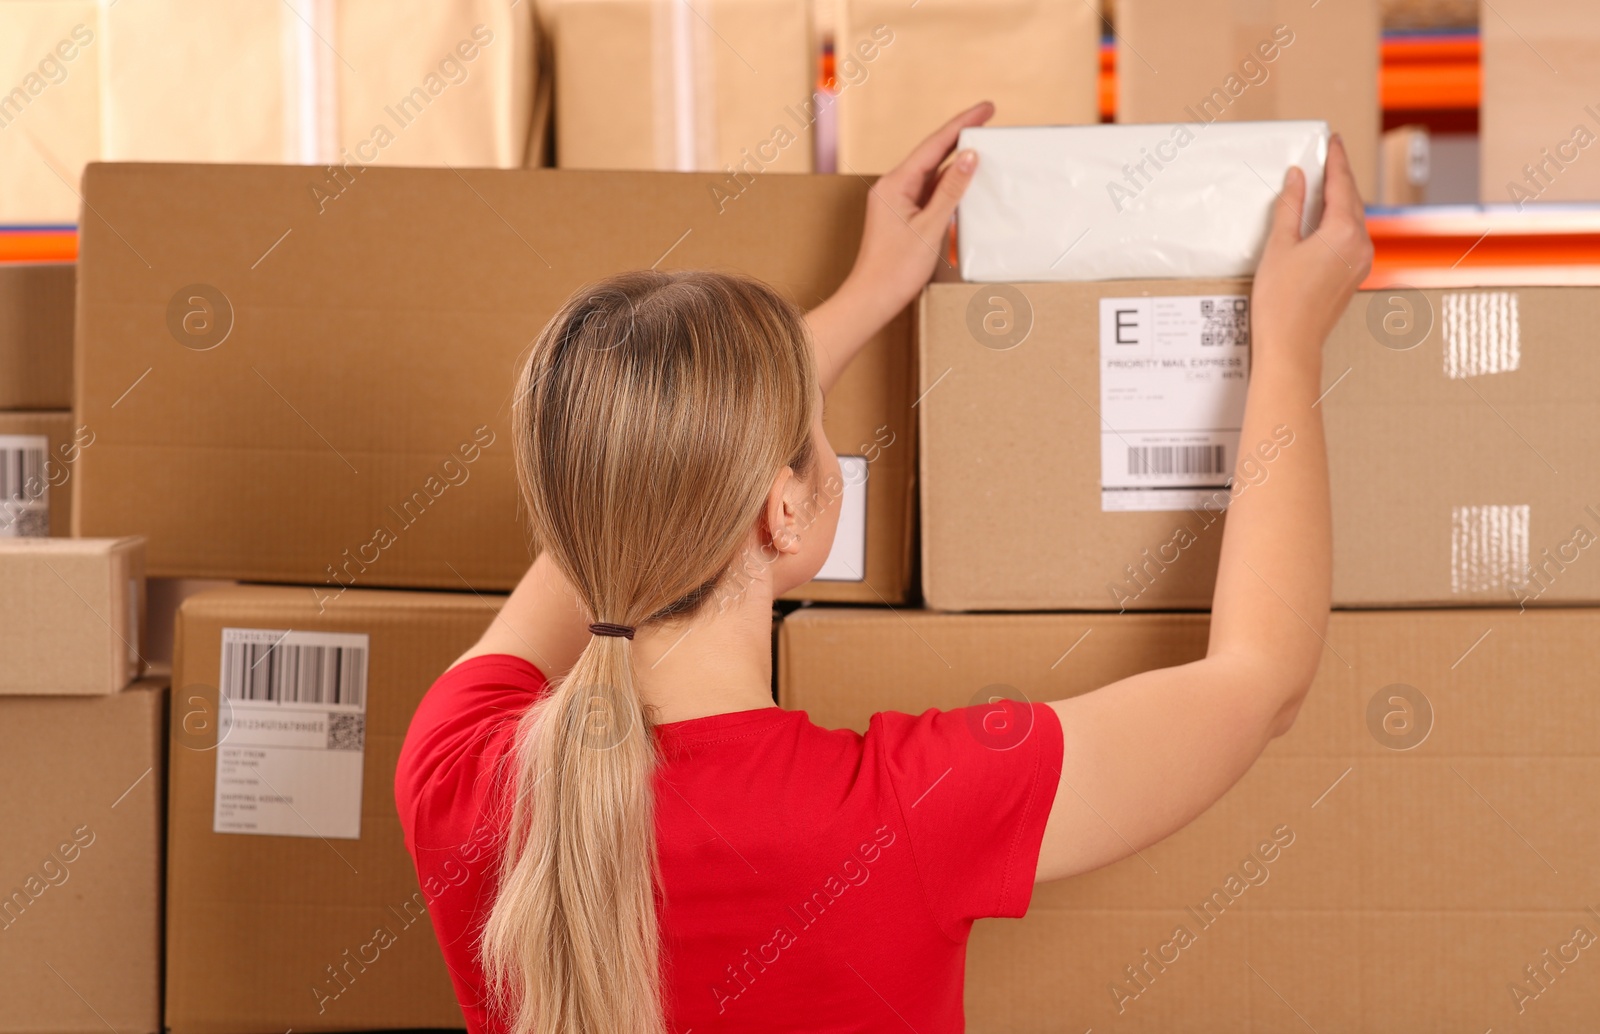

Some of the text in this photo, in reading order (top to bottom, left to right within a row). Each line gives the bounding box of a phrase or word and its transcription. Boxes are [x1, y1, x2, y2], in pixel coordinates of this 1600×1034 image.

[1115, 309, 1138, 344] E
[1107, 357, 1242, 369] PRIORITY MAIL EXPRESS
